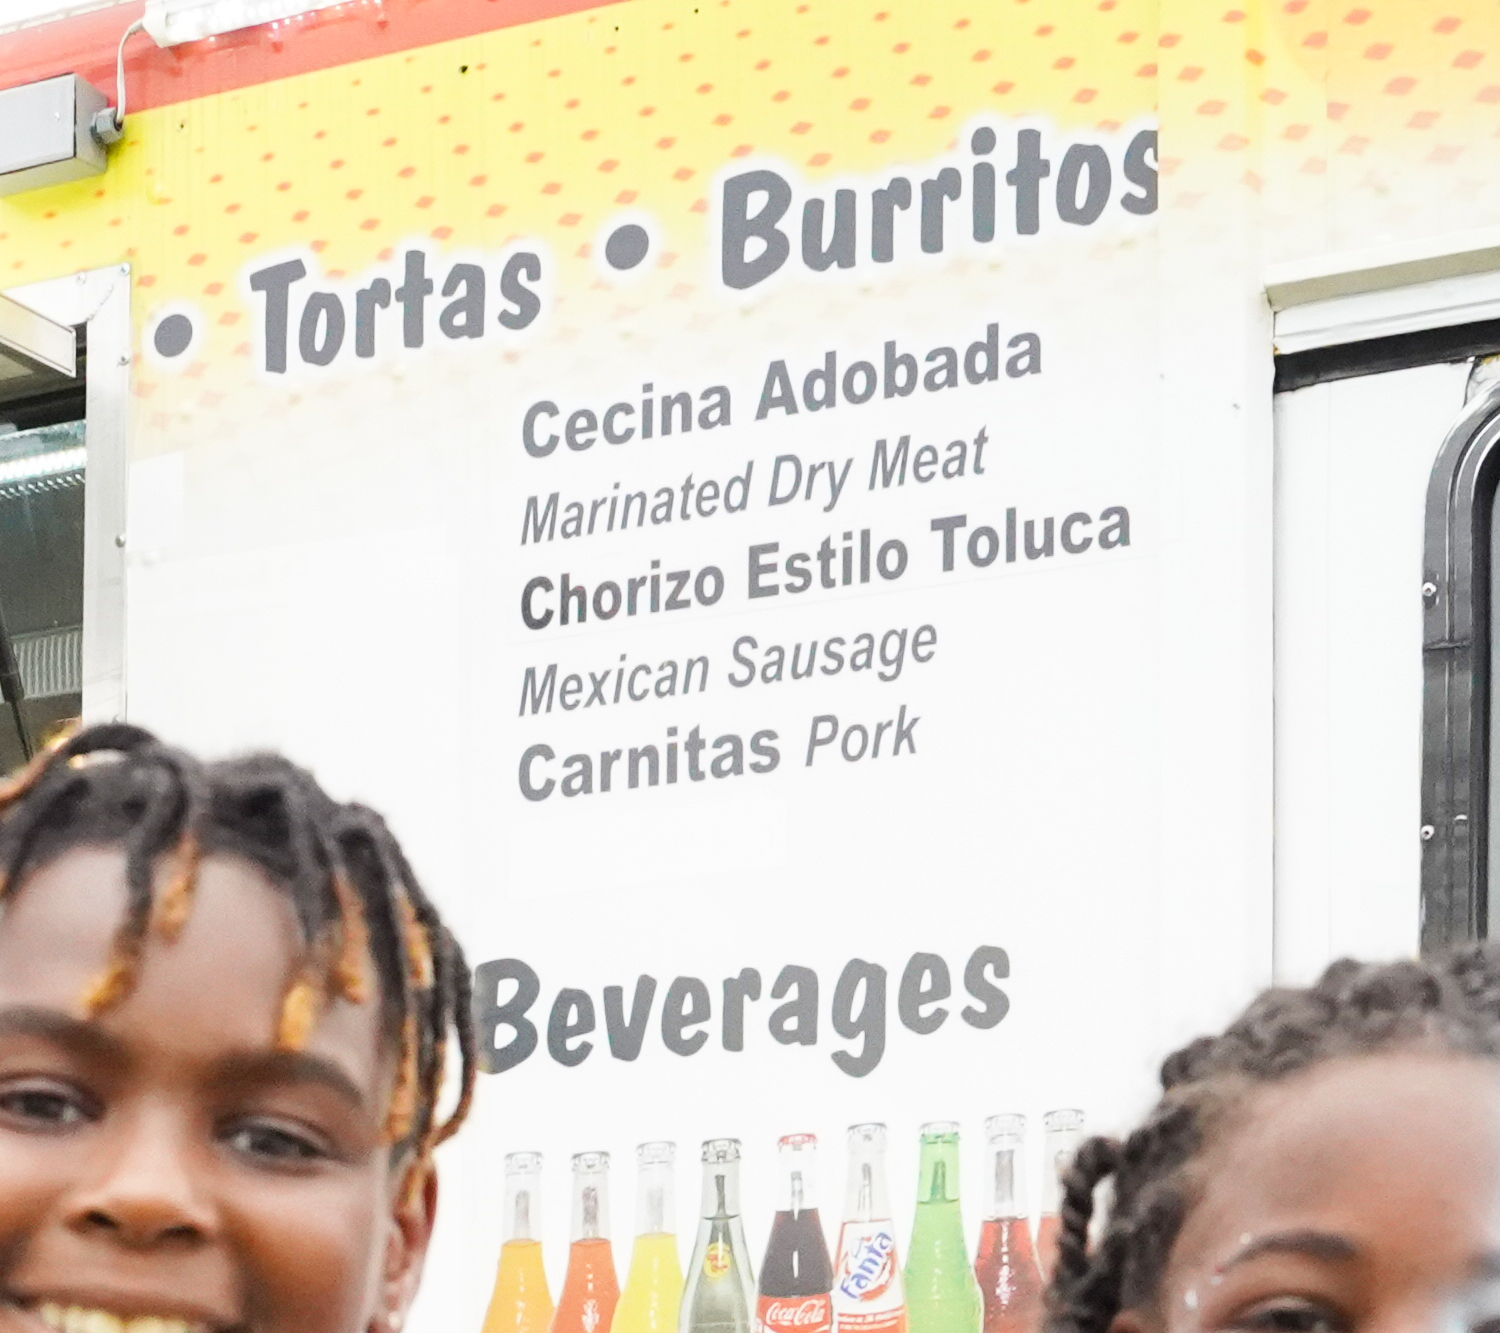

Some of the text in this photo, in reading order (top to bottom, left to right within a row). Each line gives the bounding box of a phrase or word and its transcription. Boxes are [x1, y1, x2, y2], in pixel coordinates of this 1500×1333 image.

[250, 127, 1158, 373] Tortas Burritos
[522, 323, 1042, 457] Cecina Adobada
[521, 427, 989, 545] Marinated Dry Meat
[521, 506, 1131, 630] Chorizo Estilo Toluca
[519, 623, 937, 716] Mexican Sausage
[519, 705, 920, 801] Carnitas Pork
[476, 946, 1010, 1077] Beverages
